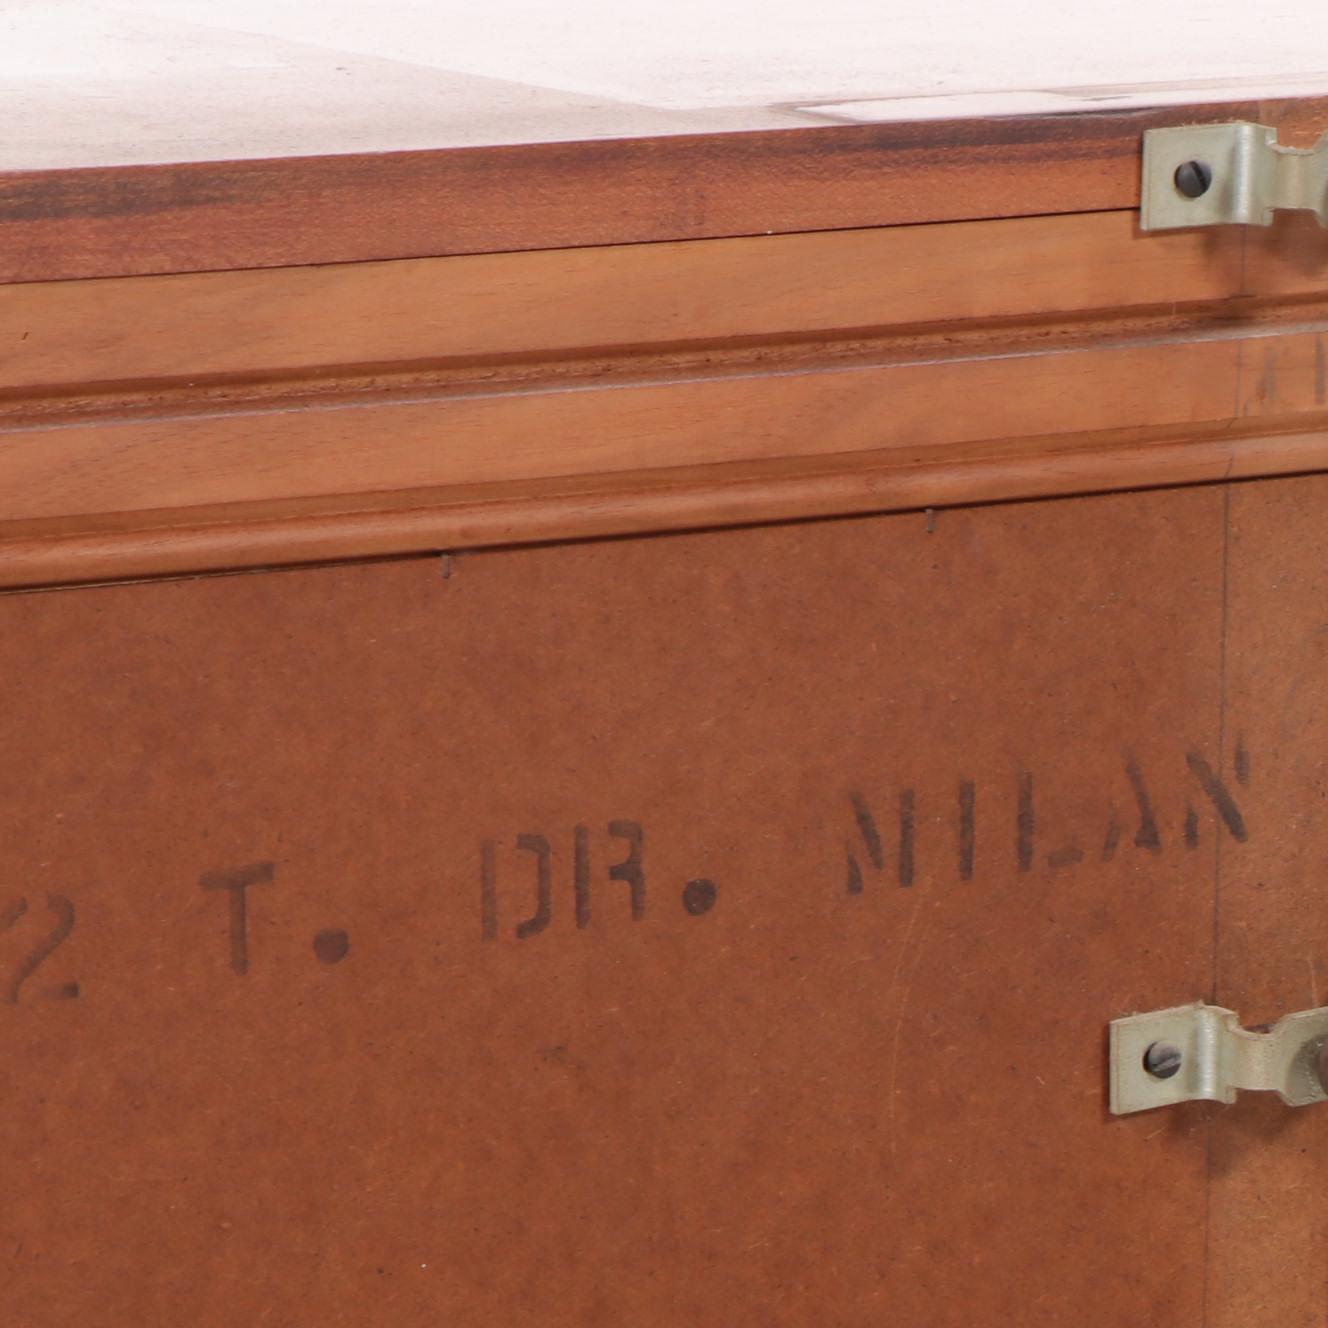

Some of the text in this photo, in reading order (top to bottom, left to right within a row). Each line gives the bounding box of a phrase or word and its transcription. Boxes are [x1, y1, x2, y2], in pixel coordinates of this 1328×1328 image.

[199, 861, 350, 976] T.
[479, 819, 716, 940] DR.
[845, 741, 1250, 894] MILAN
